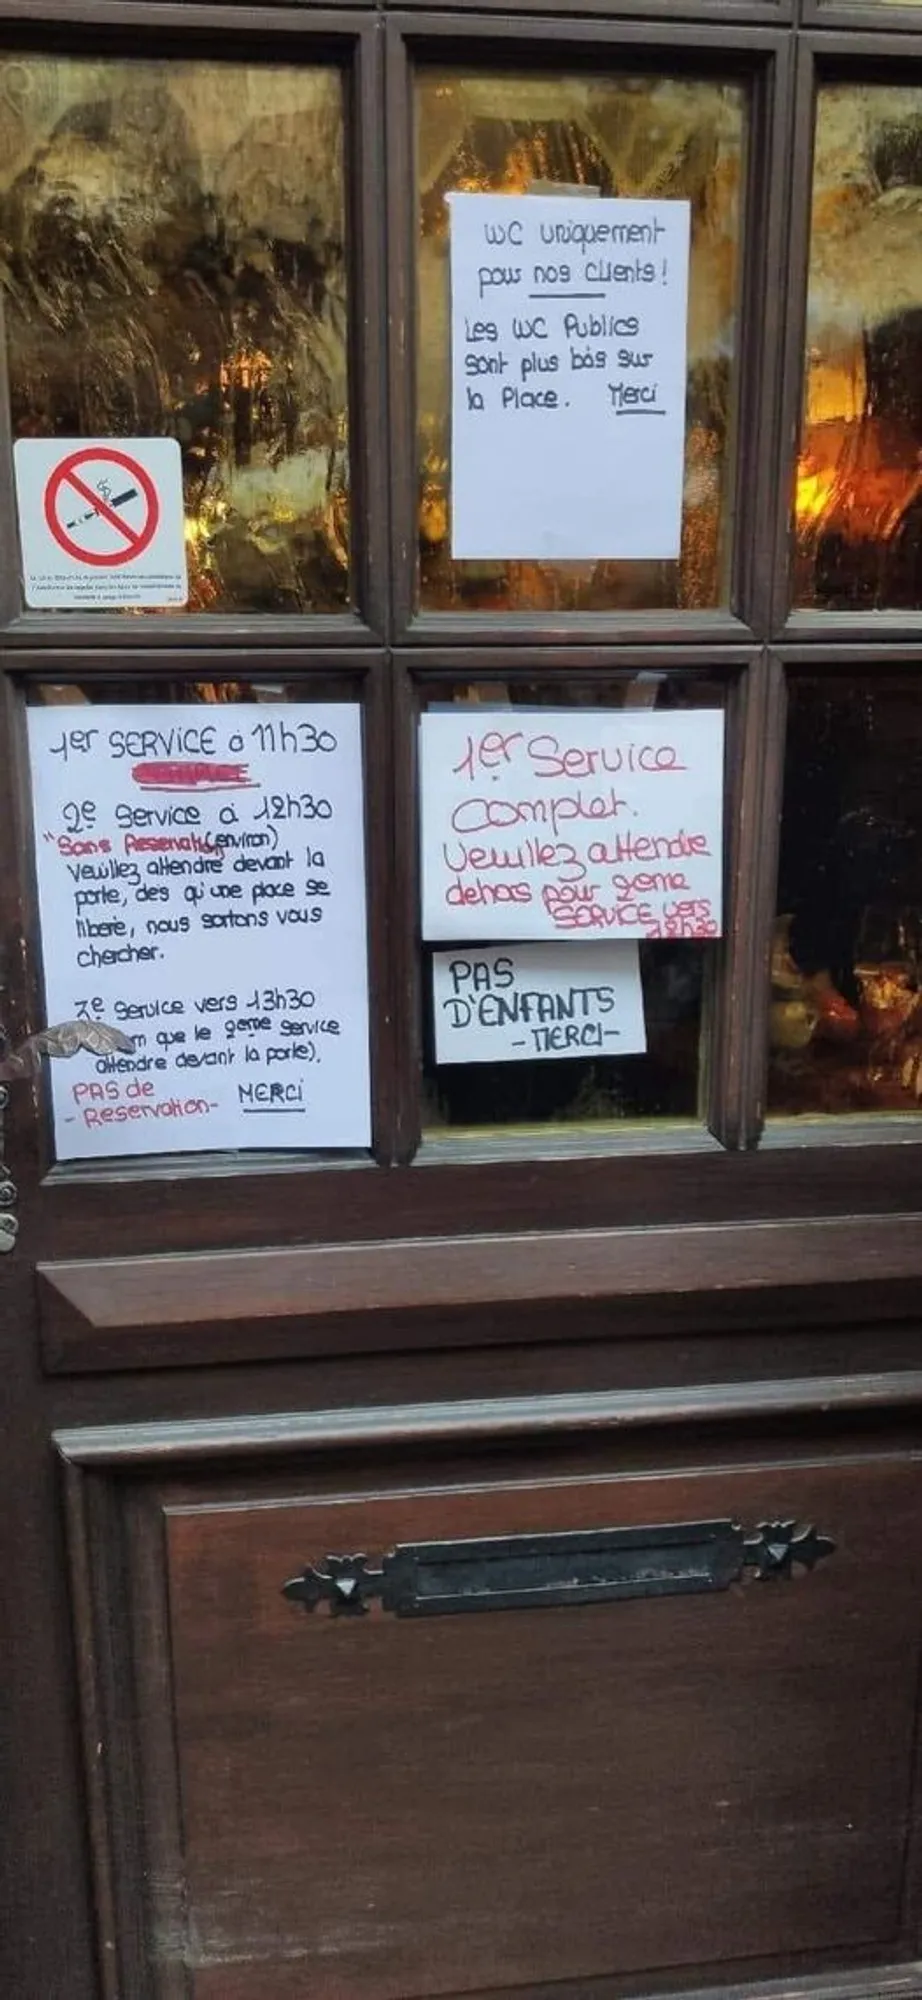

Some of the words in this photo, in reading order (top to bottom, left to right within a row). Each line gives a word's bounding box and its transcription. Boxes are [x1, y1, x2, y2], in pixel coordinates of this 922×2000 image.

[485, 220, 523, 245] WC
[541, 217, 666, 255] uniquement
[478, 266, 522, 298] pour
[534, 264, 570, 283] nos
[465, 317, 498, 342] Les
[513, 317, 548, 338] WC
[564, 313, 640, 338] Publics
[521, 351, 559, 382] plus
[618, 349, 653, 369] sur
[467, 387, 485, 410] la
[608, 382, 658, 407] Merci
[50, 729, 99, 761] 1er
[251, 723, 338, 753] 11h30
[452, 732, 524, 781] 1er
[528, 735, 688, 778] Service
[63, 801, 96, 834] 2e
[254, 794, 333, 821] 12h30
[204, 824, 279, 851] (environ)
[588, 829, 712, 862] attendre
[147, 855, 222, 876] attendre
[234, 850, 294, 873] devant
[307, 847, 325, 868] la
[74, 886, 128, 915] porte,
[252, 880, 295, 905] place
[306, 879, 331, 896] se
[445, 876, 532, 906] dehors
[542, 883, 601, 914] pour
[147, 916, 190, 935] nous
[202, 908, 268, 929] sortons
[277, 906, 323, 926] vous
[77, 944, 165, 968] chercher.
[449, 957, 515, 994] PAS
[195, 994, 238, 1012] vers
[246, 988, 315, 1010] 13h30
[442, 987, 615, 1028] D'ENFANTS
[156, 1029, 186, 1051] que
[195, 1025, 211, 1041] le
[96, 1052, 167, 1074] attendre
[175, 1046, 236, 1068] devant
[245, 1043, 260, 1062] la
[266, 1041, 321, 1064] porte).
[72, 1082, 119, 1105] PAS
[125, 1078, 155, 1098] de
